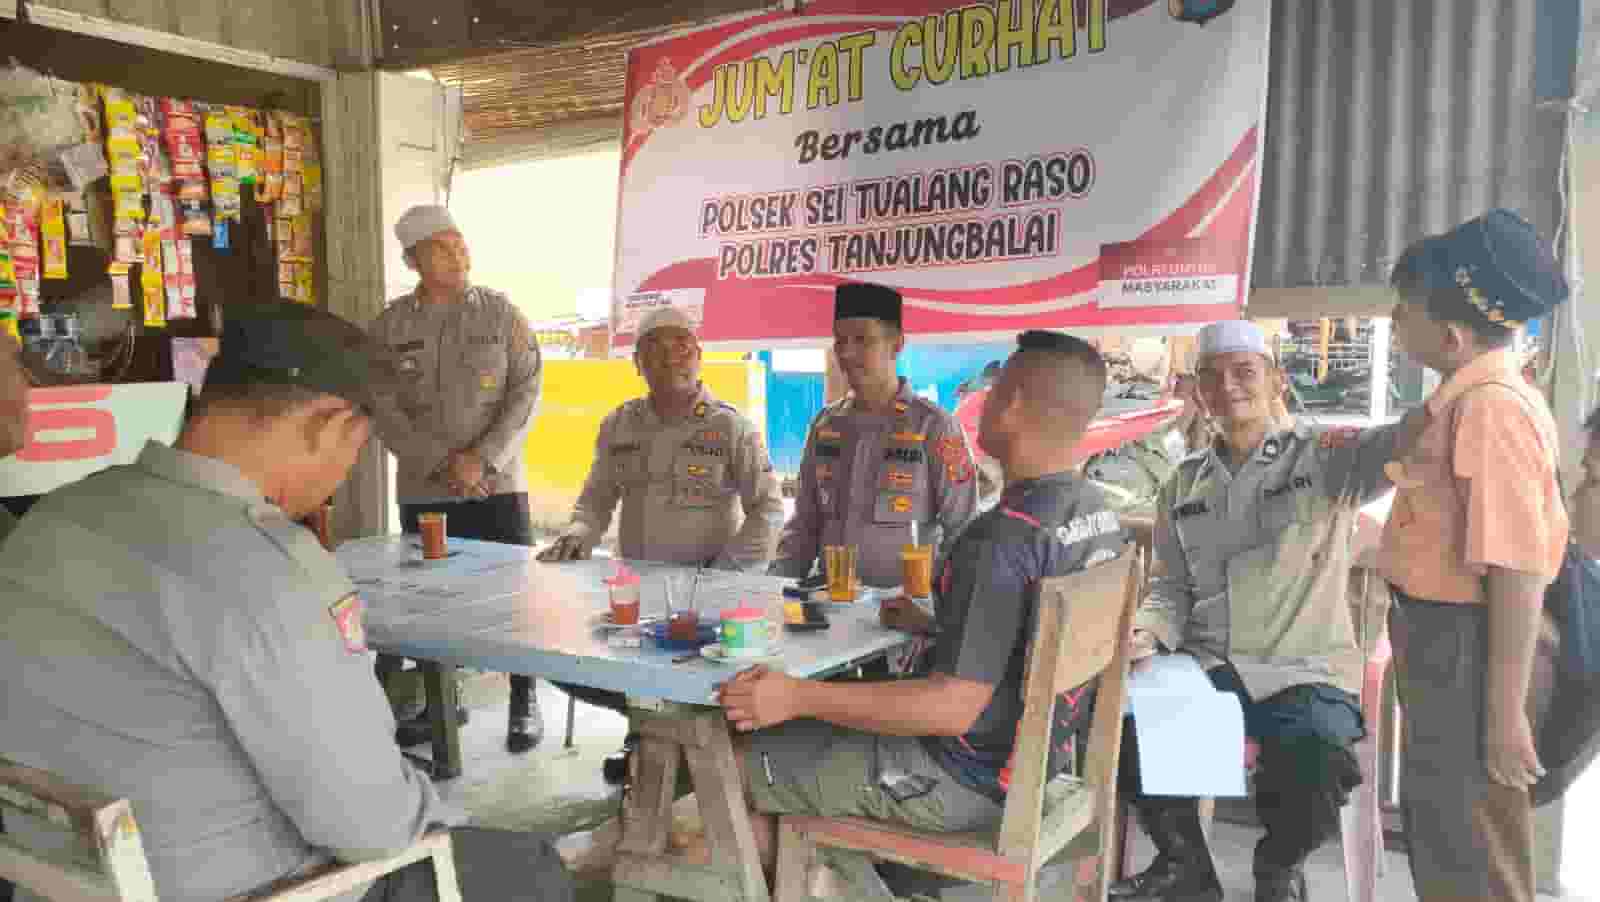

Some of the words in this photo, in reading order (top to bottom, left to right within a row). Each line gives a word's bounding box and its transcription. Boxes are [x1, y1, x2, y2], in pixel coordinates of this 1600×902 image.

[695, 30, 877, 128] JUM'AT
[794, 110, 982, 165] Bersama
[701, 193, 800, 234] POLSEK
[806, 187, 845, 226] SEI
[854, 167, 993, 220] TUALANG
[1002, 151, 1093, 204] RASO
[718, 238, 818, 279] POLRES
[827, 211, 1058, 272] TANJUNGBALAI
